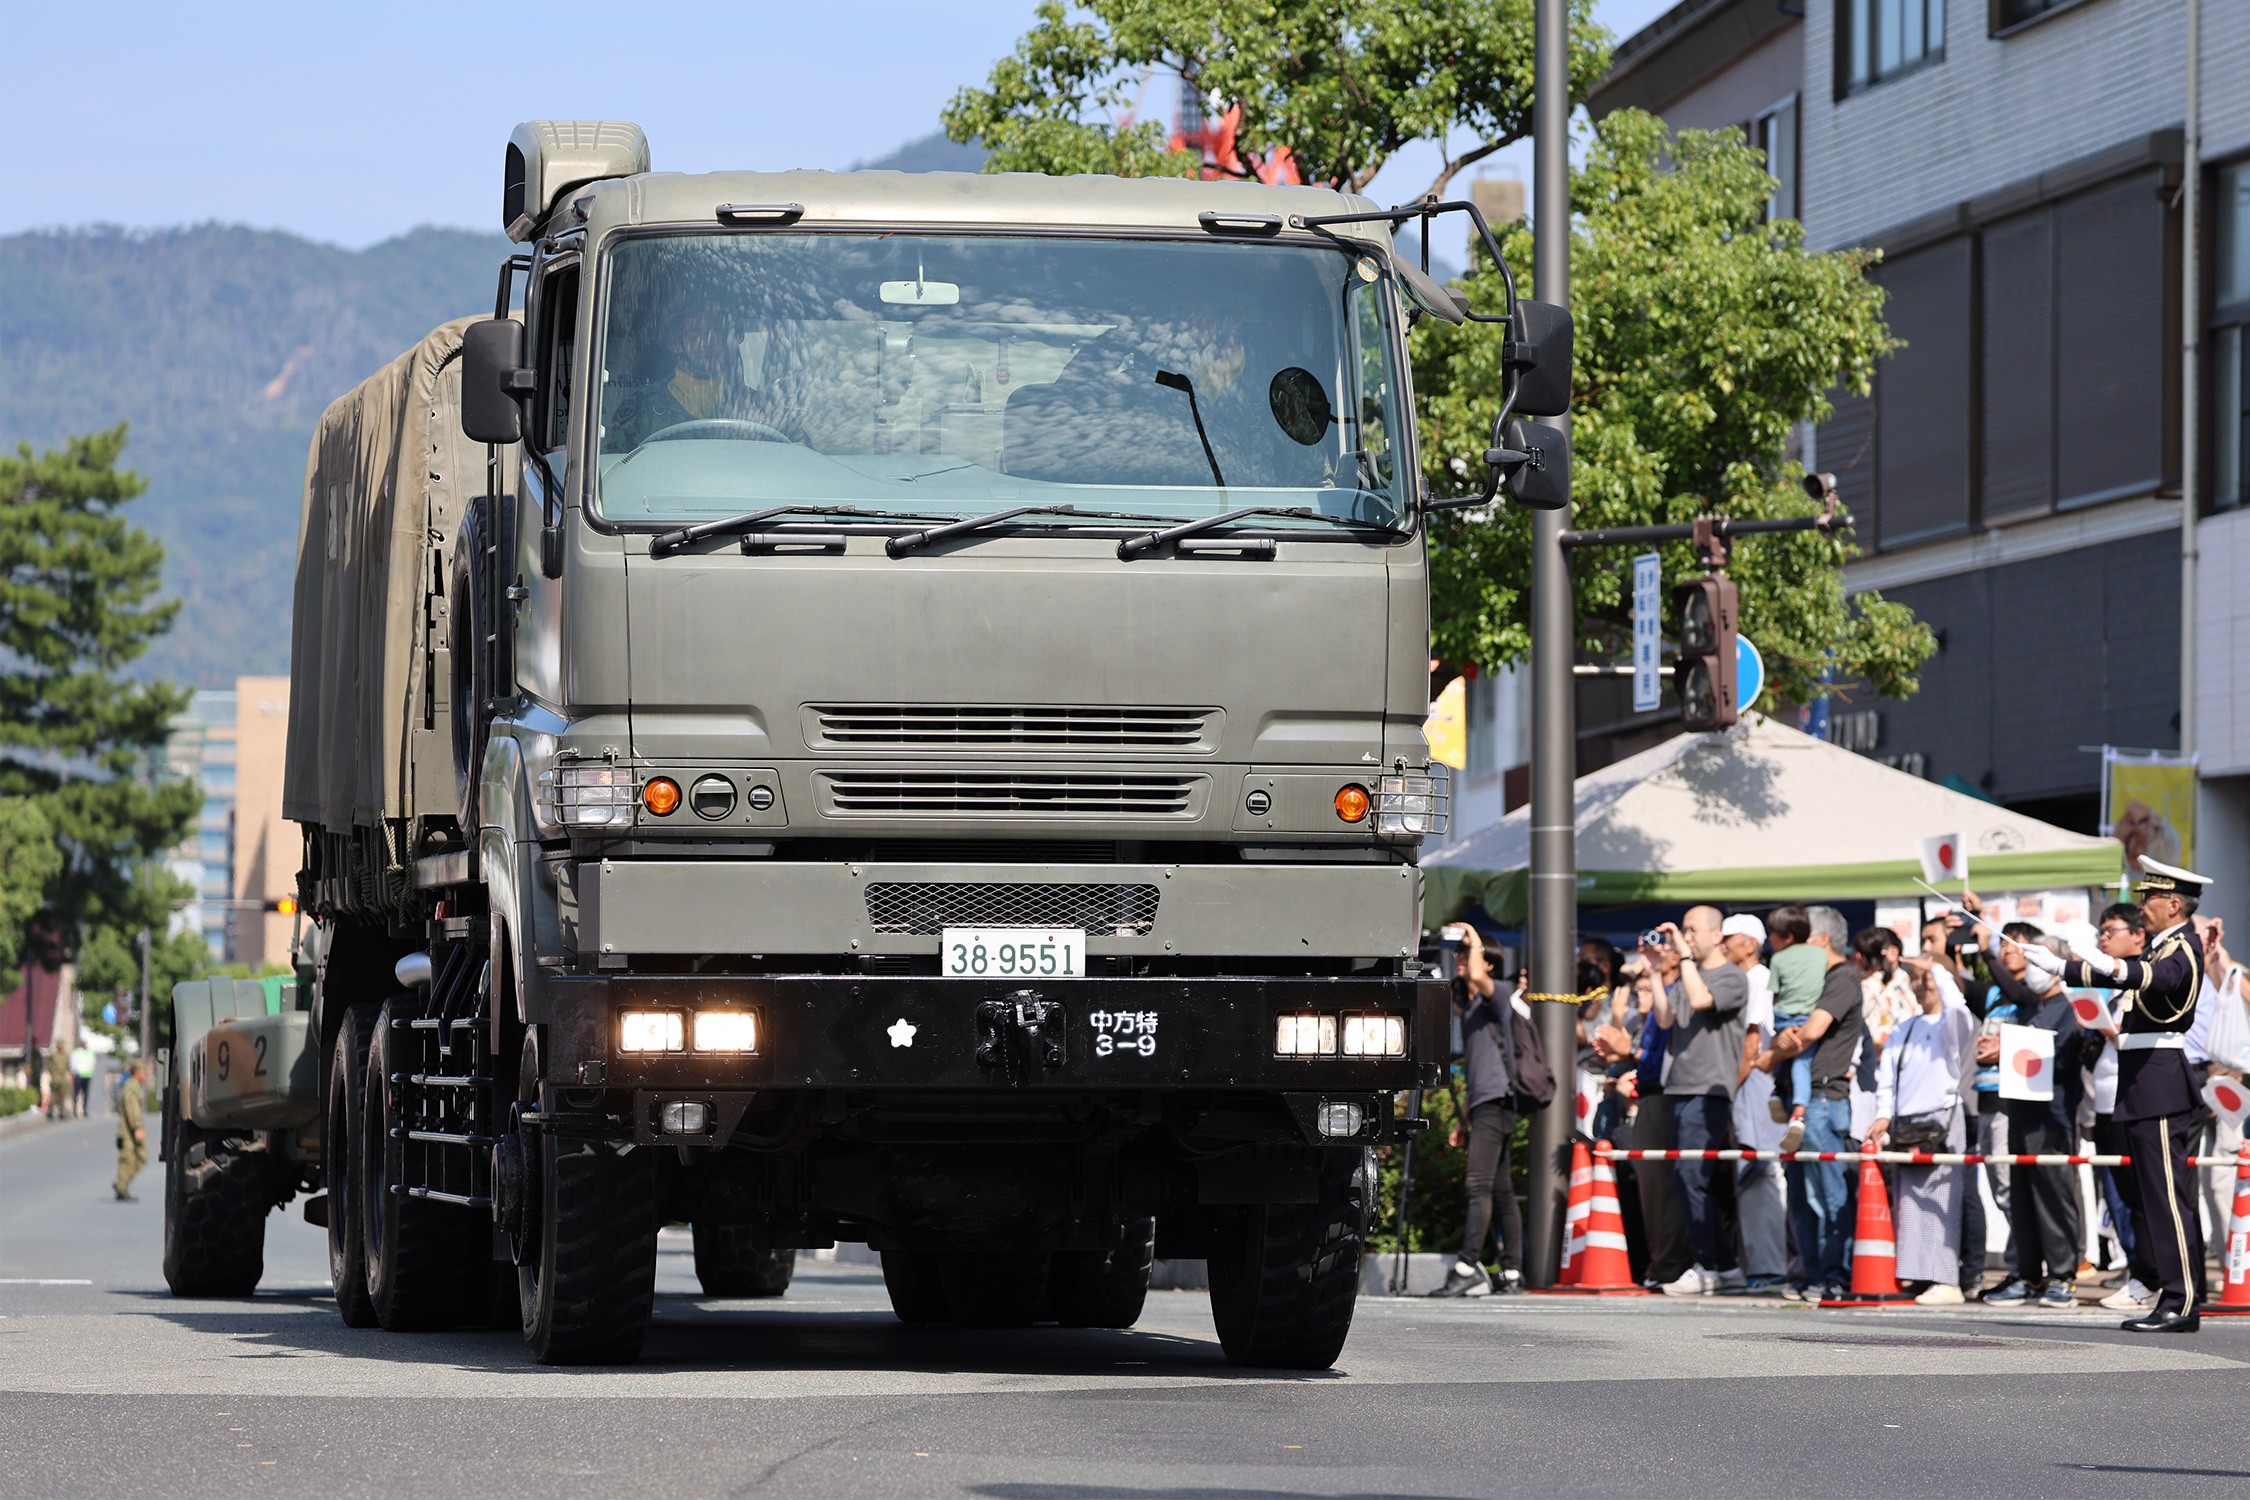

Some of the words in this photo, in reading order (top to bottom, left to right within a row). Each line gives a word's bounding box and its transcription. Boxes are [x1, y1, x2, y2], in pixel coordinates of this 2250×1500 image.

[951, 943, 1074, 975] 38-9551
[1090, 1010, 1159, 1034] 中方特
